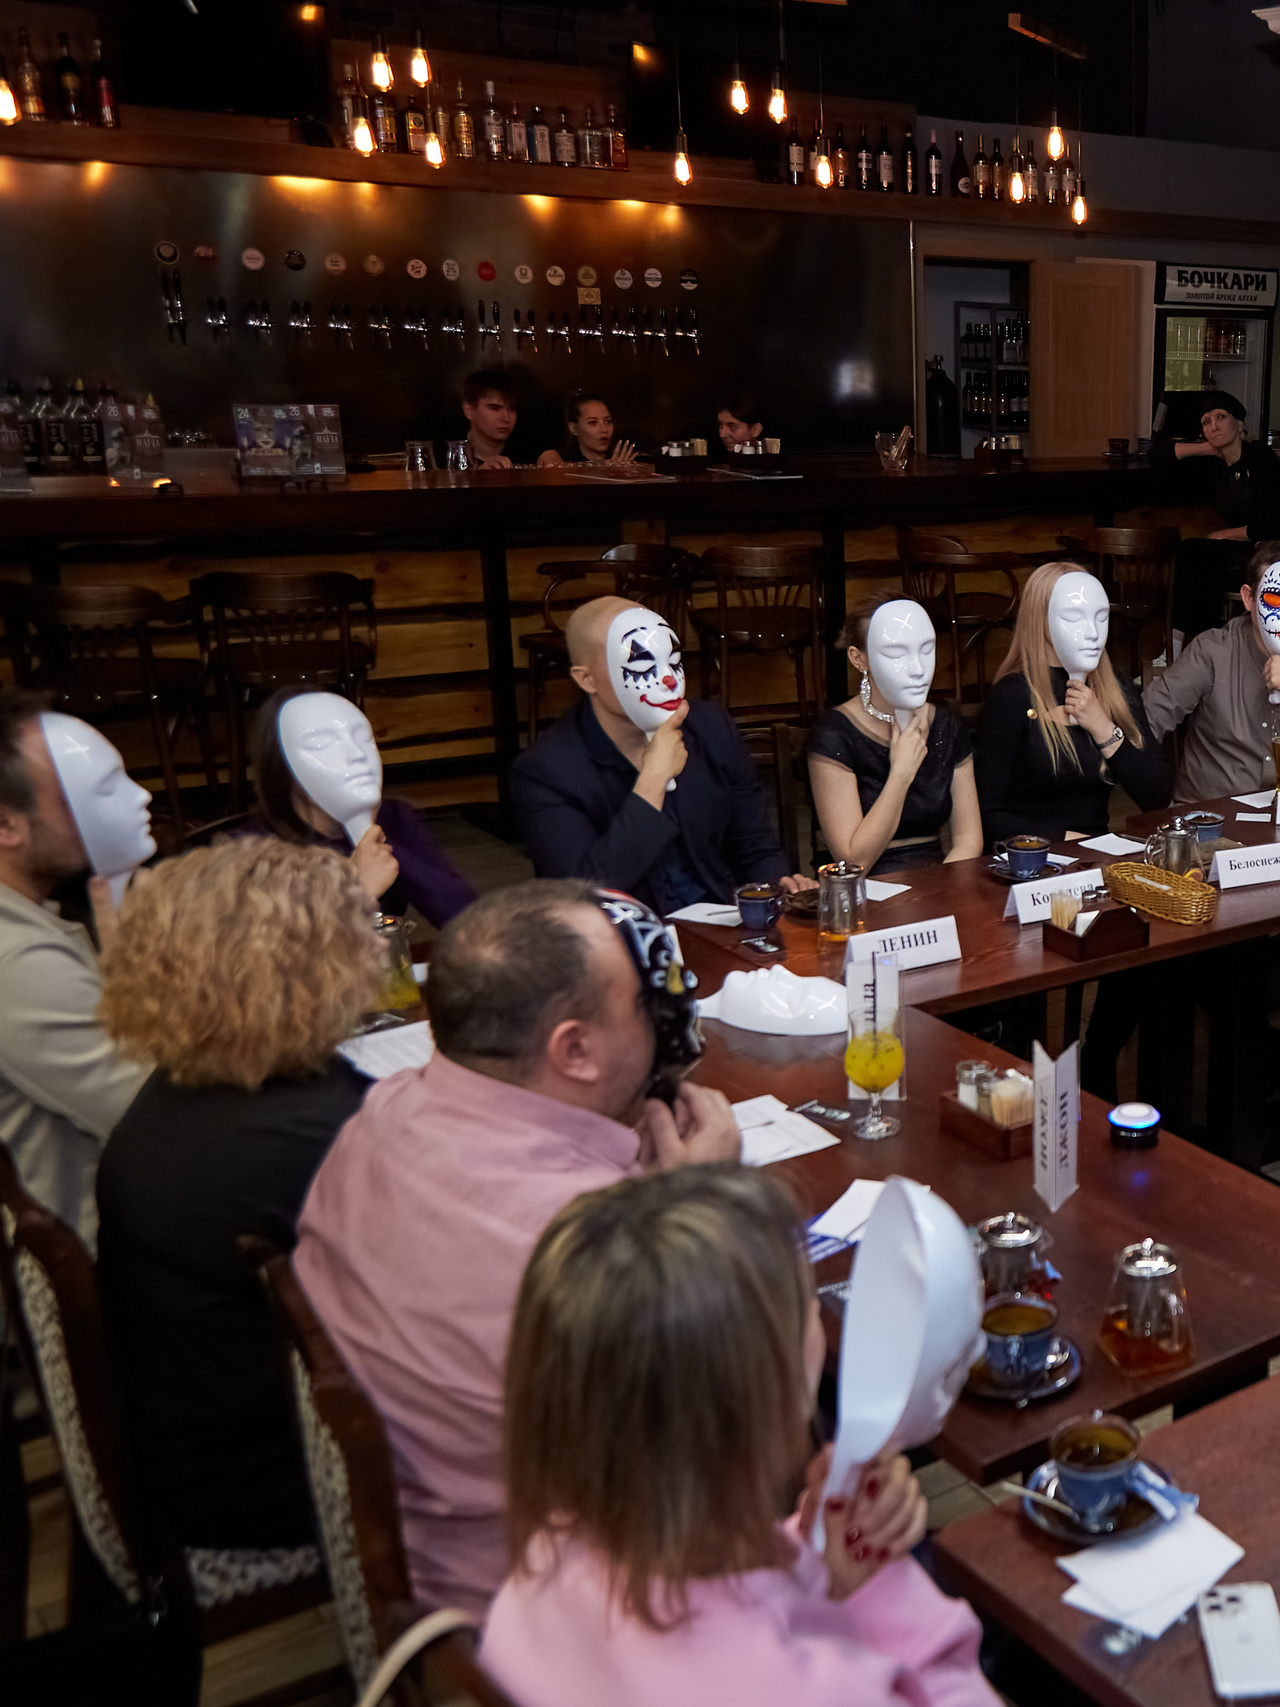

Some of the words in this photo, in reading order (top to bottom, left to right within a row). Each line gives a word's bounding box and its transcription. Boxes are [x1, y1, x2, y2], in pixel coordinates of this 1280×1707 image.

[1177, 269, 1267, 292] БОЧКАРИ
[1185, 292, 1215, 301] ЗОЛОТОЙ
[1216, 293, 1236, 302] БРЕНД
[238, 407, 250, 419] 24
[876, 929, 939, 954] ЛЕНИН
